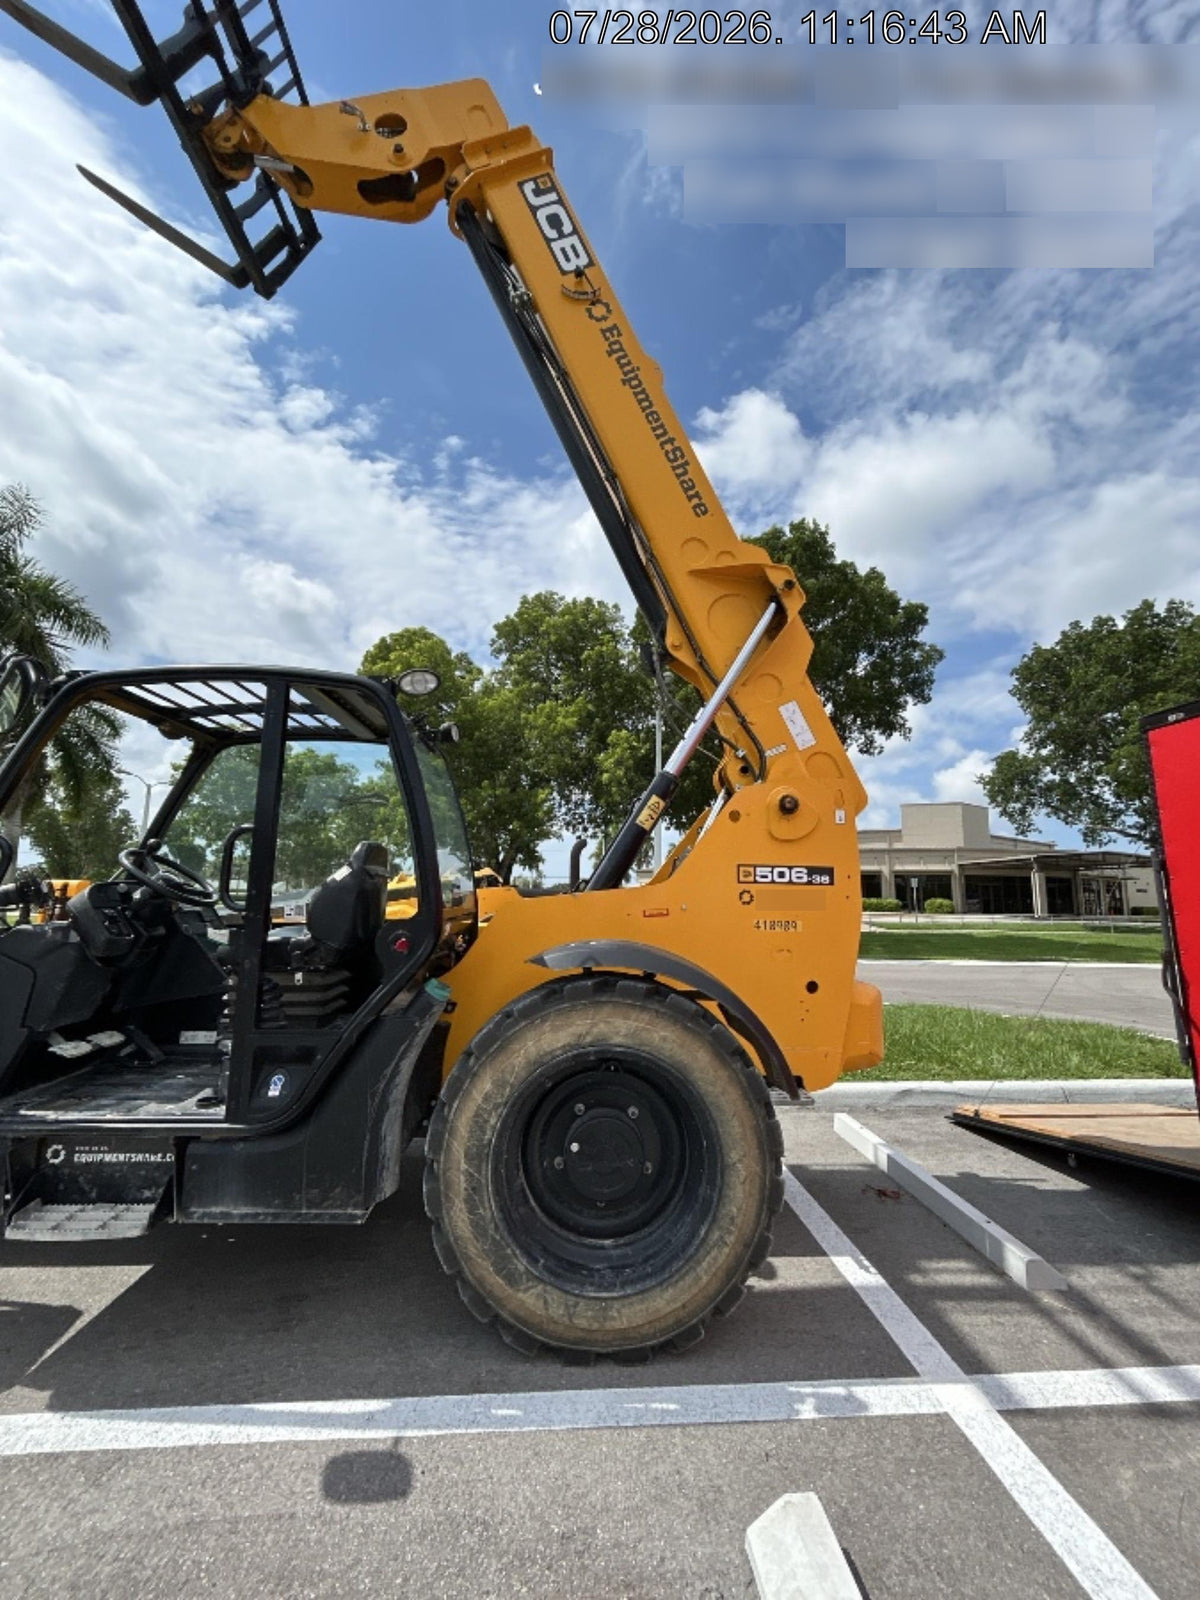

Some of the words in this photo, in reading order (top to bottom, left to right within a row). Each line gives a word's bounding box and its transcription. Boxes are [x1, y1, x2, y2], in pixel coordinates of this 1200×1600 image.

[521, 179, 590, 273] JCB
[600, 325, 710, 518] EquipmentShare
[755, 866, 830, 885] 506-38
